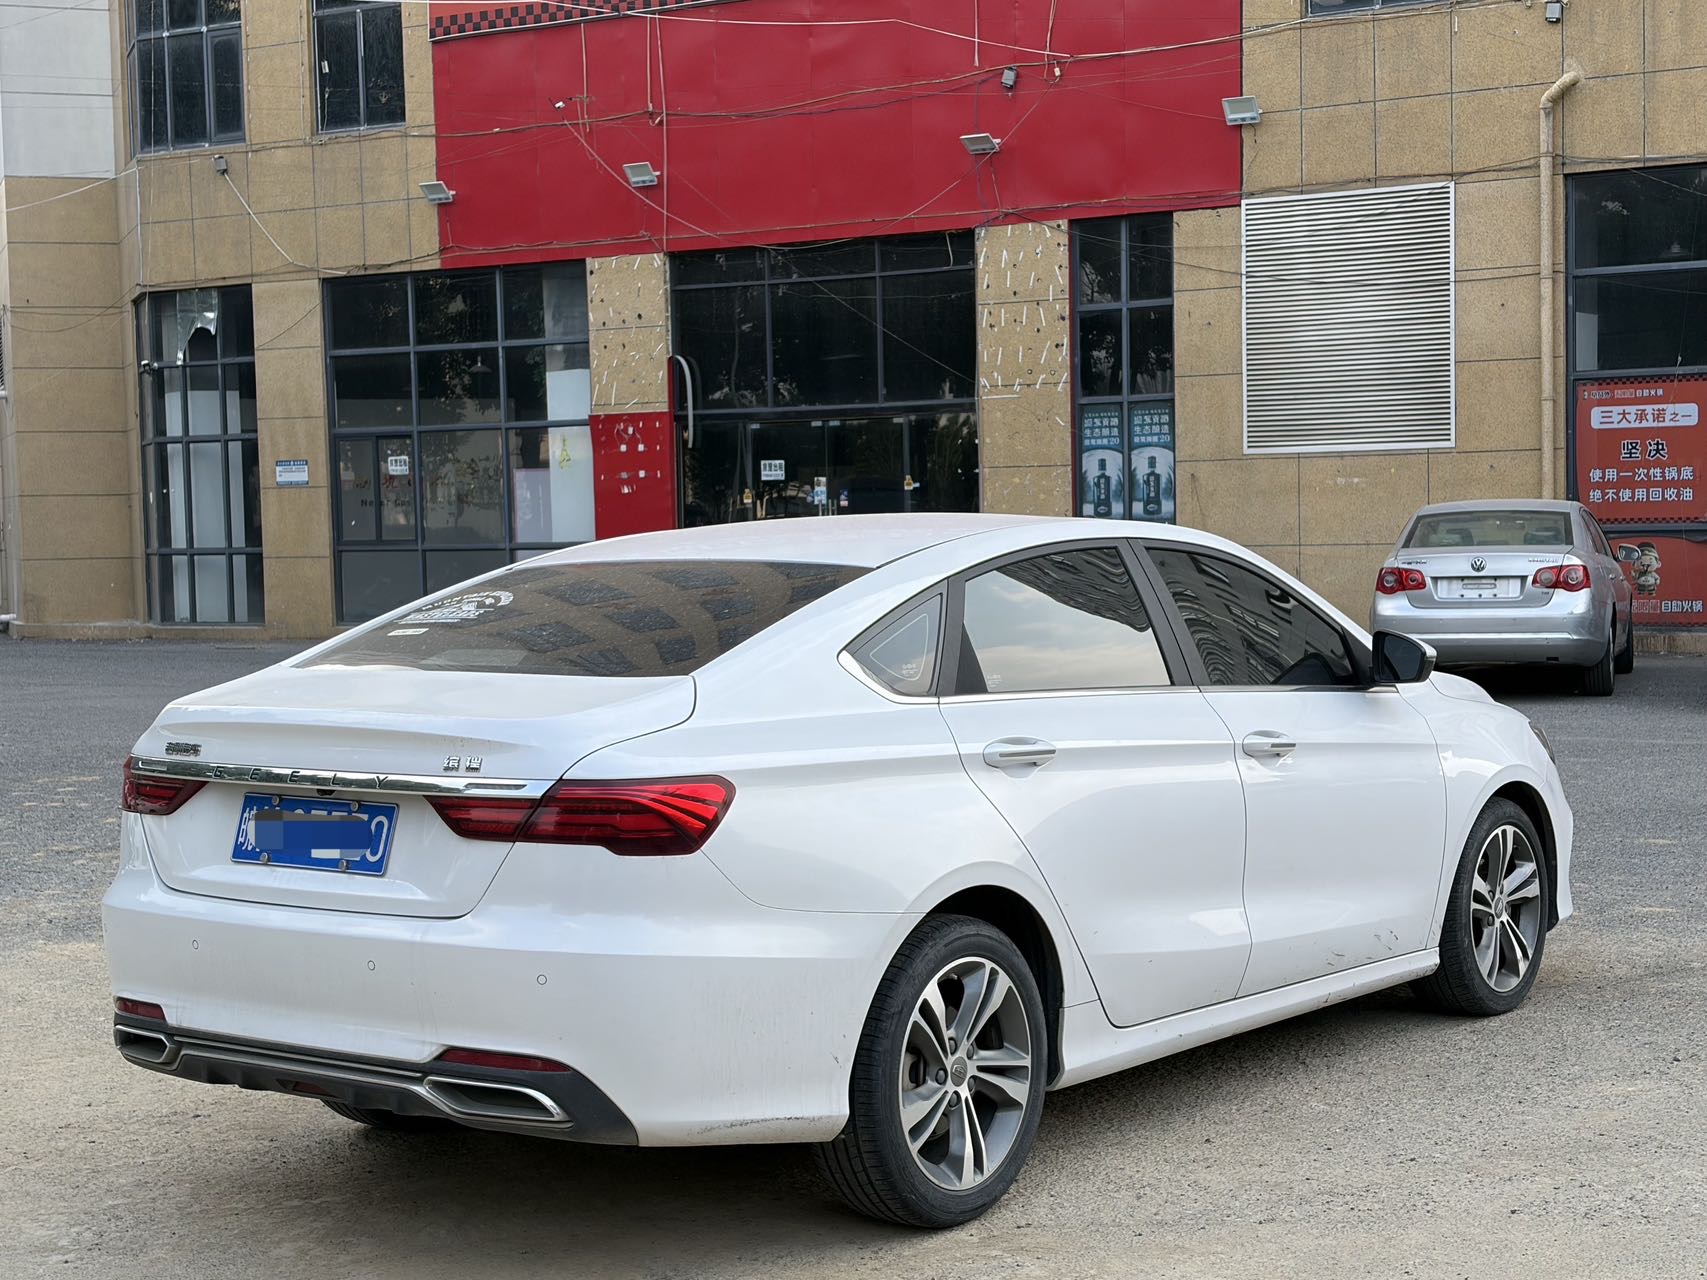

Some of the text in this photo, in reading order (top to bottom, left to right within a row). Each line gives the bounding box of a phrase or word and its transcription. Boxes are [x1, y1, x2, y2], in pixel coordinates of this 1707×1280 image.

[1599, 407, 1693, 425] 三大承诺之一
[1620, 438, 1668, 460] 坚决
[1589, 466, 1694, 482] 使用一次性锅底
[1589, 487, 1693, 502] 绝不使用回收油
[1661, 600, 1703, 613] 自助火锅
[212, 765, 388, 789] GEELY
